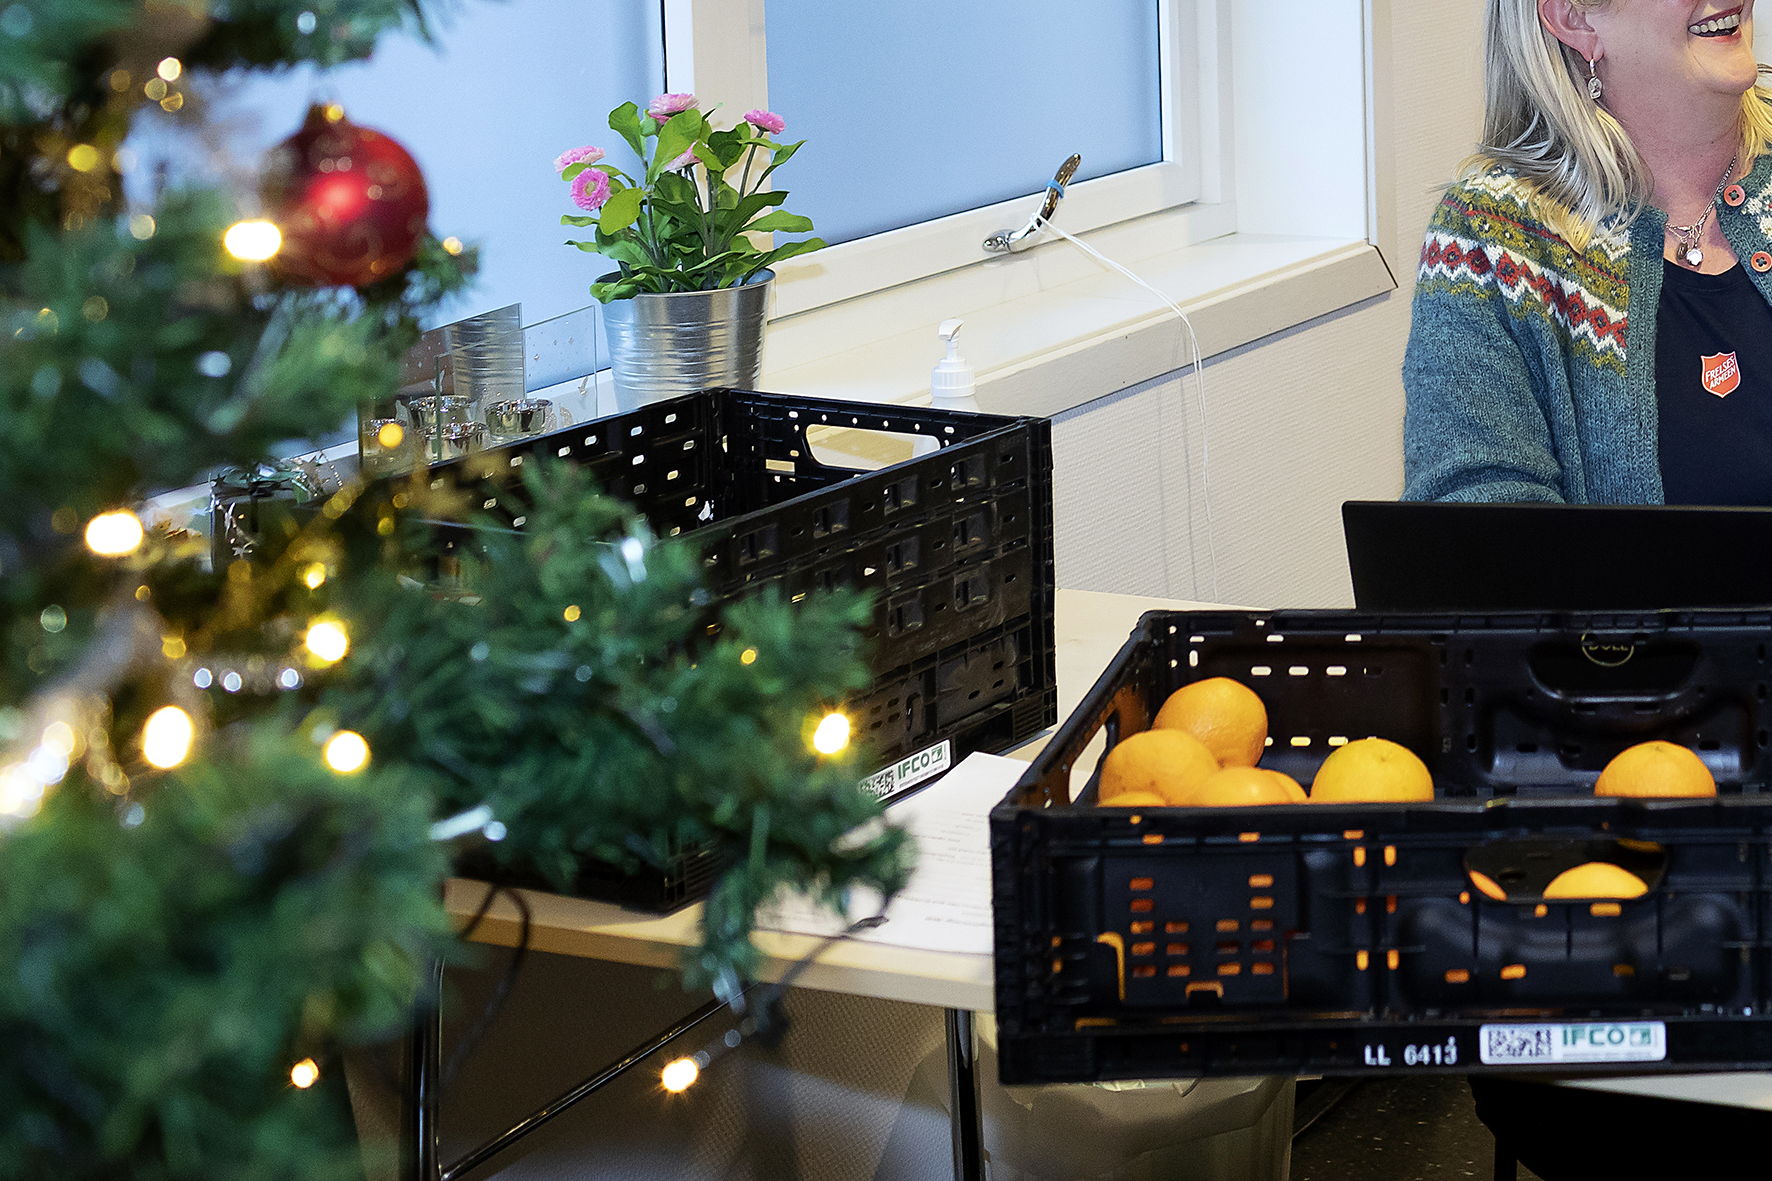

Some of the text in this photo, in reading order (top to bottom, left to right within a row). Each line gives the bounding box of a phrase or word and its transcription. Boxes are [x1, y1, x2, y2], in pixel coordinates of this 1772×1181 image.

[1705, 355, 1735, 383] FRELSES
[1709, 365, 1736, 390] ARMEEN
[898, 752, 930, 780] IFCO
[1563, 1024, 1625, 1046] IFCO
[1364, 1043, 1391, 1066] LL
